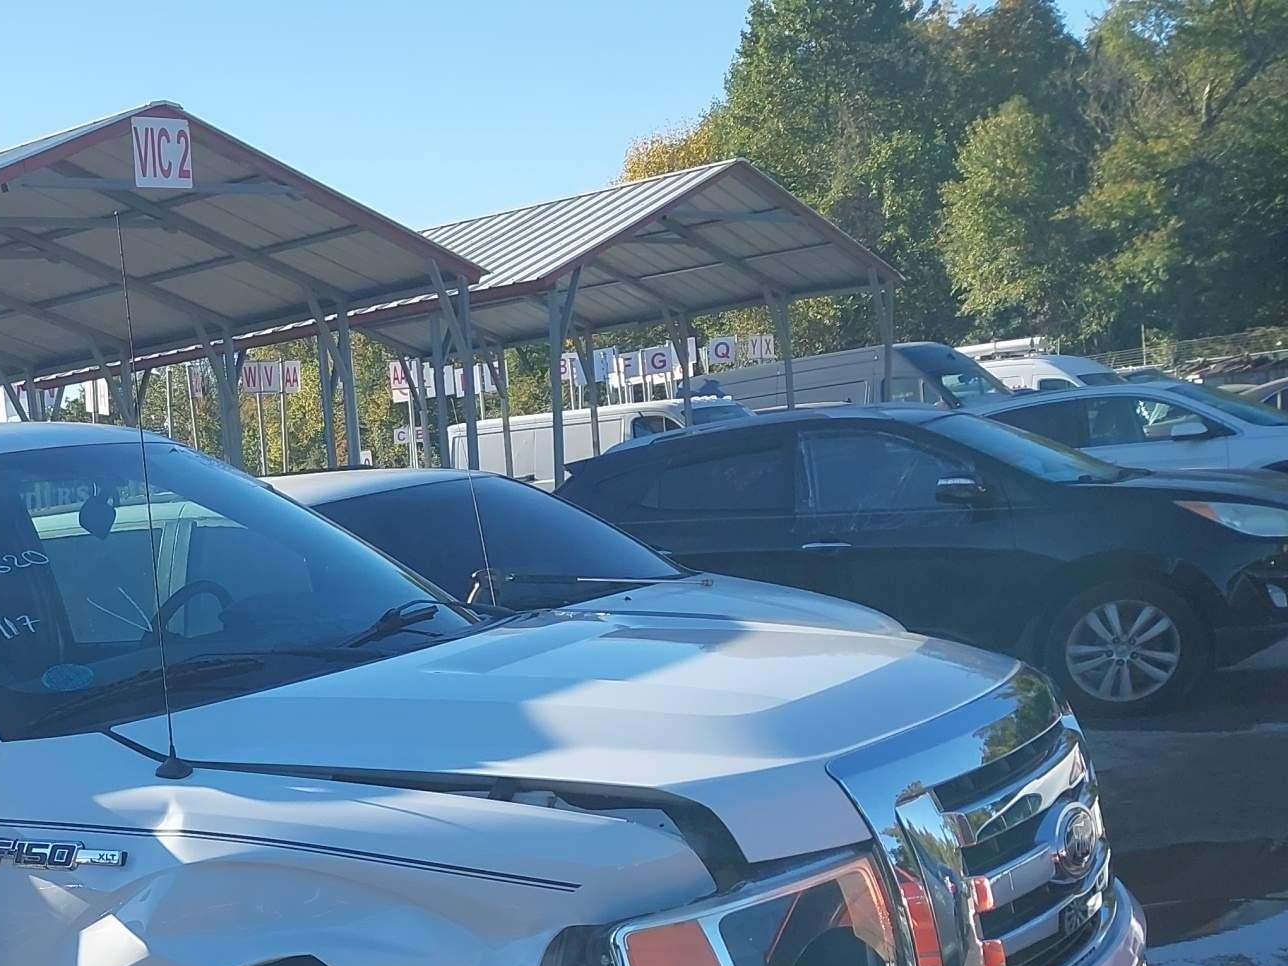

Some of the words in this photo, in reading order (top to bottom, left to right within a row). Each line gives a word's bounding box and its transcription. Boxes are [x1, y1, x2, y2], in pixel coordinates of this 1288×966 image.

[133, 126, 172, 179] VIC
[177, 129, 191, 179] 2
[714, 341, 730, 359] Q
[651, 352, 667, 370] G
[243, 366, 257, 388] W
[264, 366, 273, 387] V
[285, 366, 299, 388] AA
[397, 431, 406, 441] C
[97, 852, 117, 862] XLT
